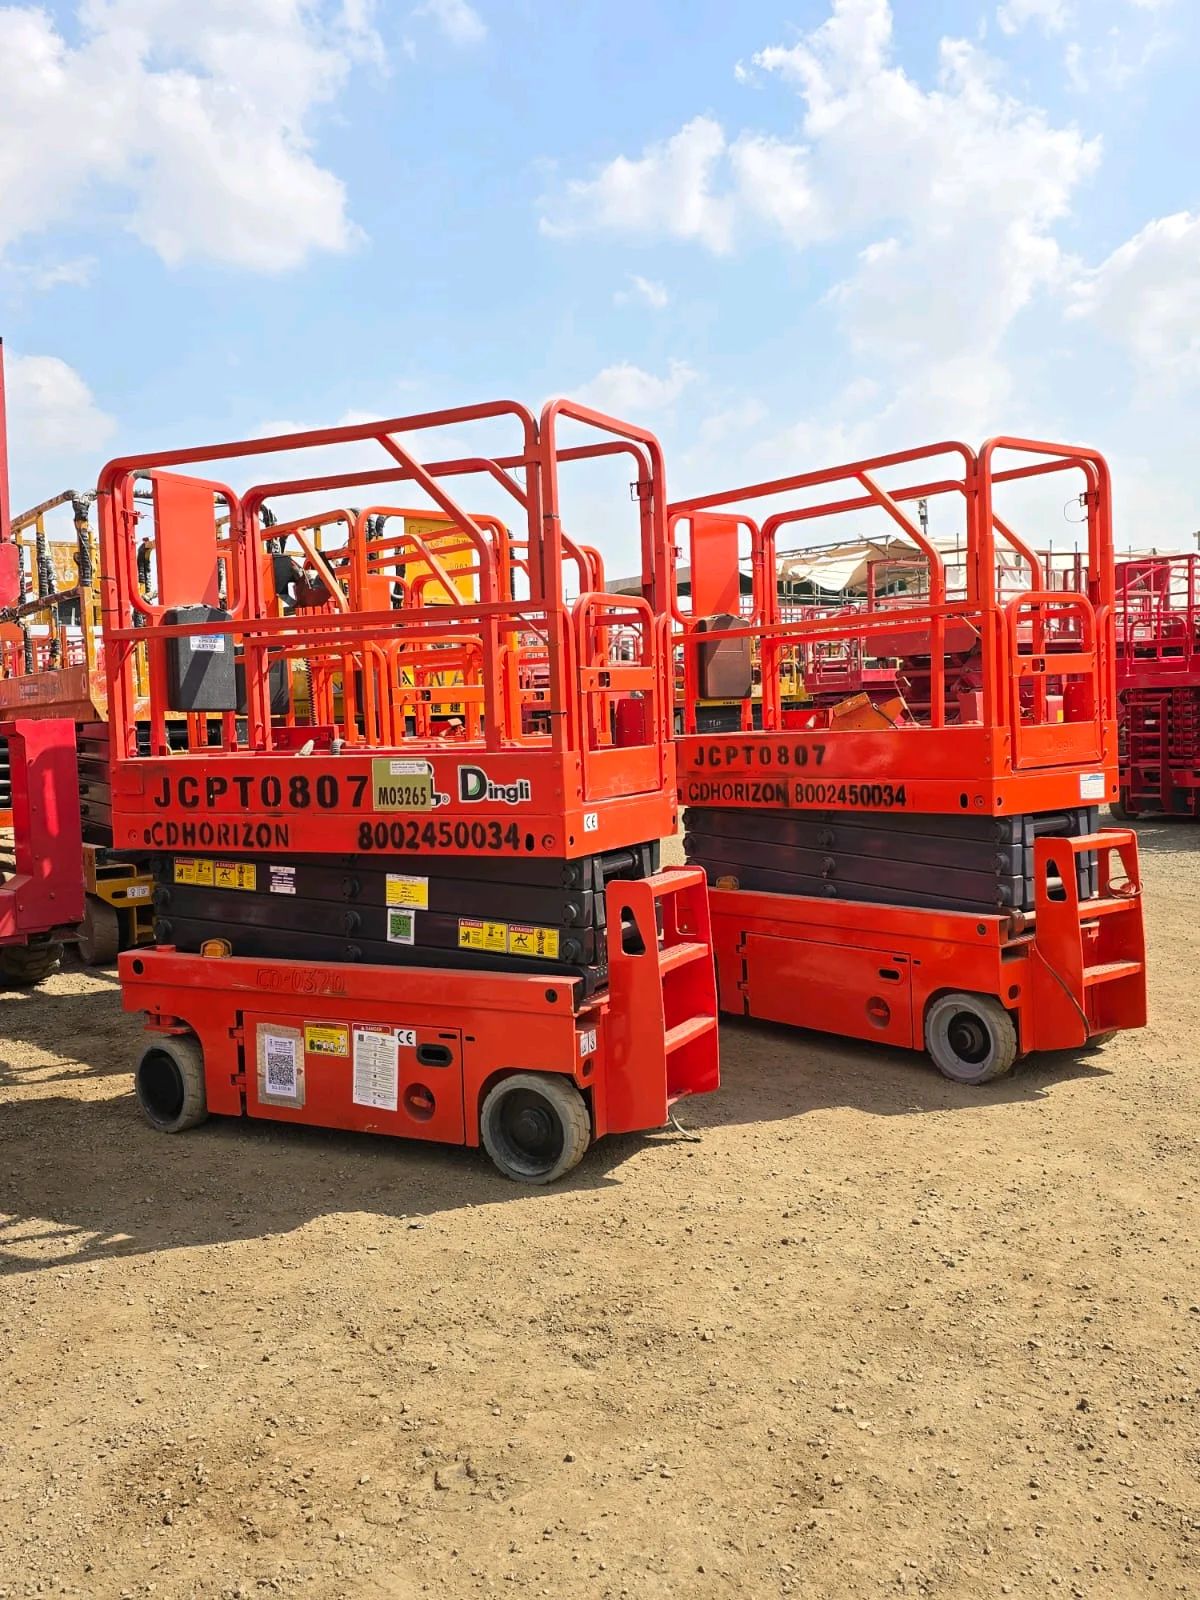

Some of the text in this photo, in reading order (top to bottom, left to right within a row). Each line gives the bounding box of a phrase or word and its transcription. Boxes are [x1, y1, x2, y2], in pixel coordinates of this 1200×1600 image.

[694, 744, 826, 767] JCPT0807
[155, 776, 368, 808] JCPT0807
[378, 786, 427, 806] M03265
[460, 766, 530, 803] Dingli
[688, 782, 907, 807] CDHORIZON 8002450034
[151, 821, 521, 851] CDHORIZON 8002450034
